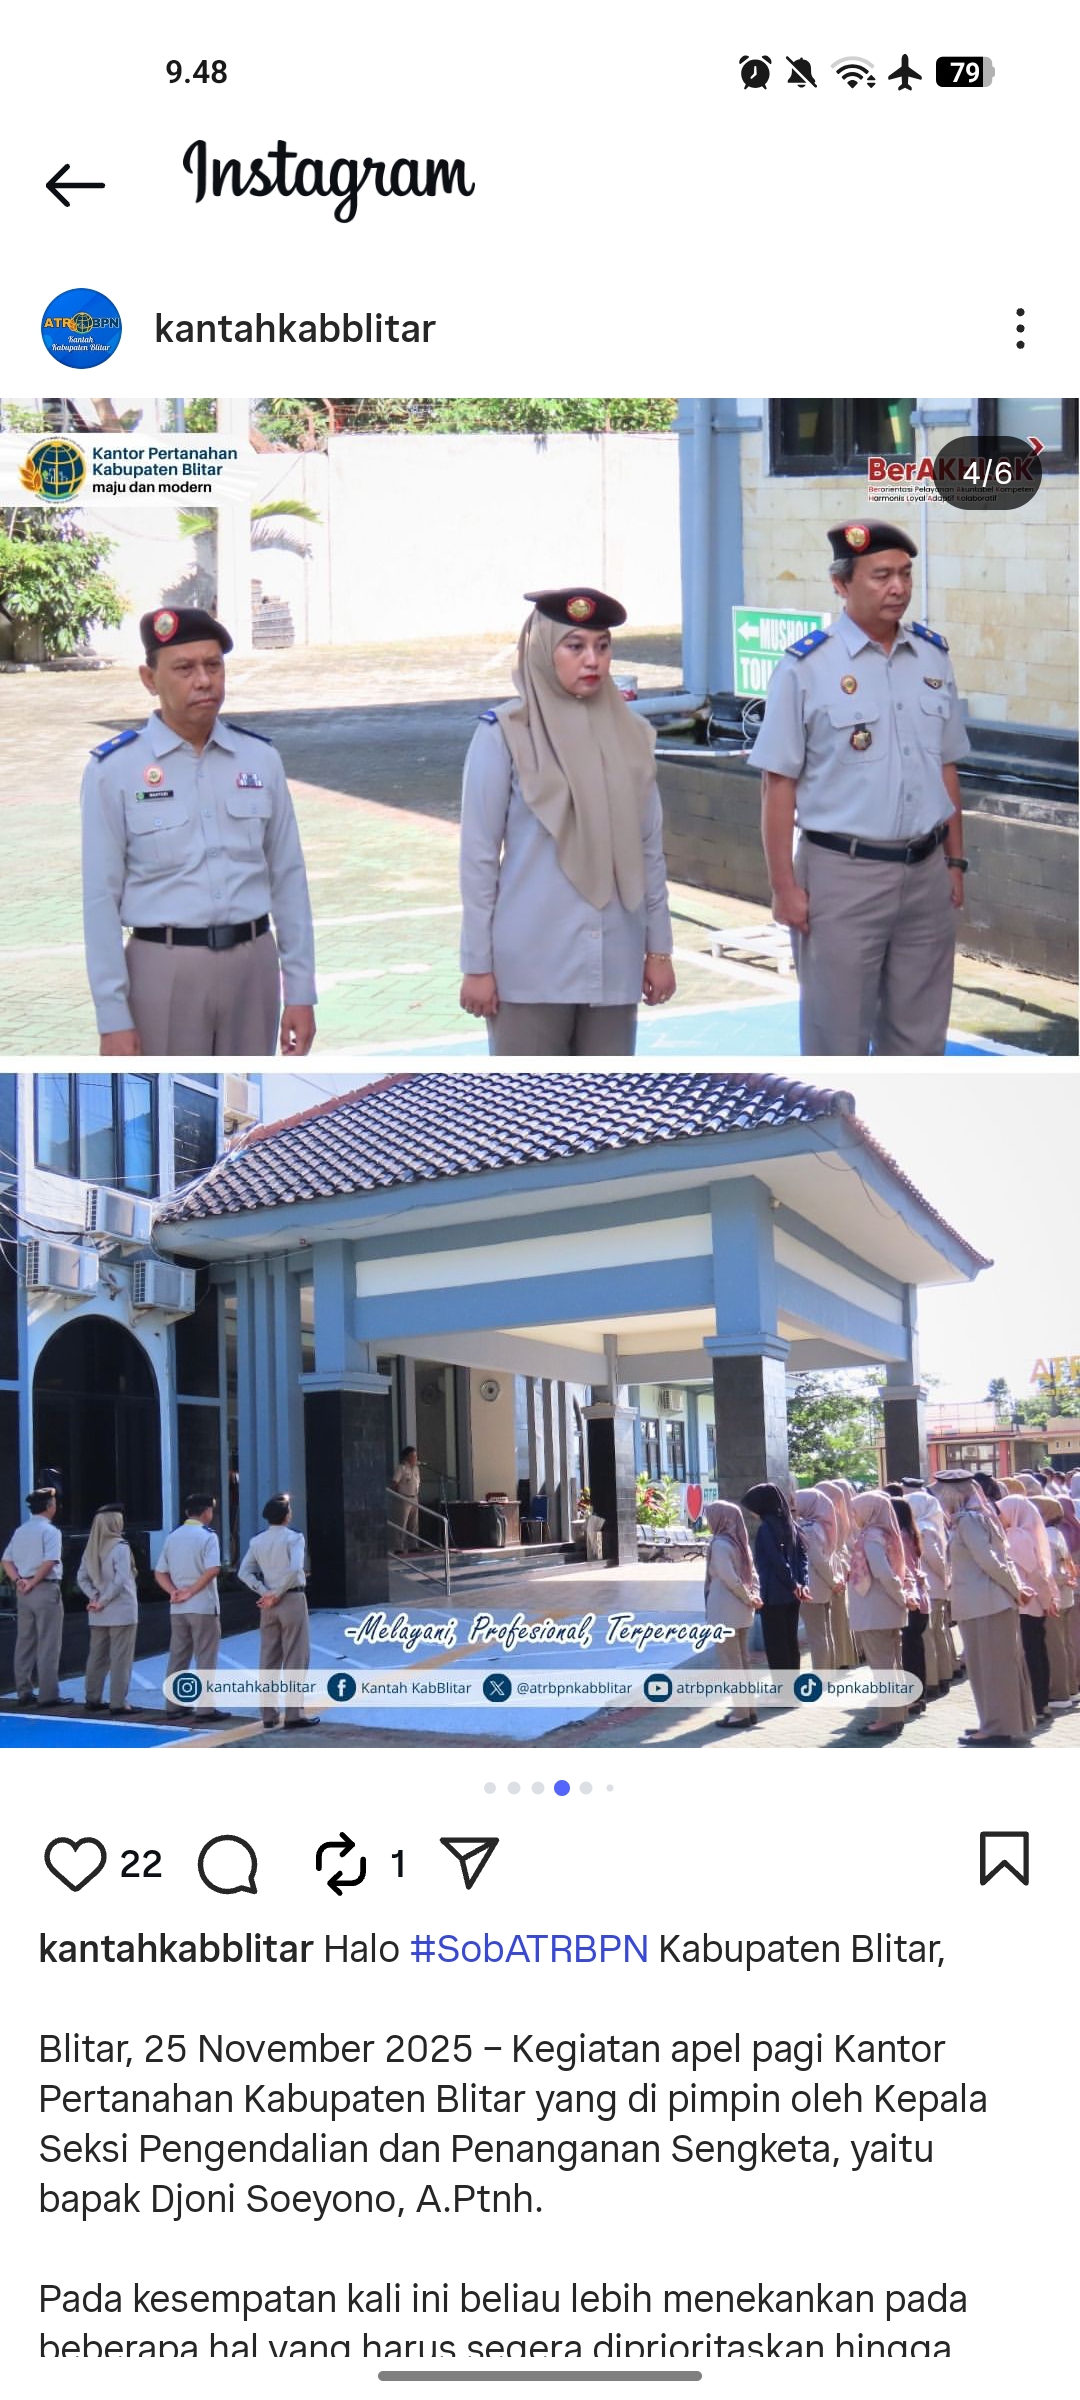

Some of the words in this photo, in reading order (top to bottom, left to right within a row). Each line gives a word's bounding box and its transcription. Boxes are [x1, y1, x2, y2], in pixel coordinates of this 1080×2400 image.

[166, 60, 227, 84] 9.48
[950, 62, 980, 83] 79
[183, 139, 475, 224] Instagram
[92, 317, 120, 329] BPN
[156, 312, 437, 343] kantahkabblitar
[52, 344, 88, 353] Kabupaten
[963, 459, 1012, 488] 4/6
[120, 1849, 162, 1878] 22
[392, 1849, 404, 1878] 1
[41, 1933, 314, 1962] kantahkabblitar
[326, 1933, 399, 1962] Halo
[410, 1933, 647, 1962] #SobATRBPN
[661, 1933, 839, 1971] Kabupaten
[853, 1933, 945, 1968] Blitar,
[41, 2033, 132, 2067] Blitar,
[145, 2035, 185, 2062] 25
[200, 2033, 374, 2062] November
[386, 2035, 471, 2062] 2025
[514, 2033, 659, 2071] Kegiatan
[672, 2033, 739, 2071] apel
[754, 2033, 822, 2071] pagi
[836, 2035, 945, 2062] Kantor
[41, 2083, 232, 2112] Pertanahan
[246, 2083, 424, 2121] Kabupaten
[438, 2083, 525, 2112] Blitar
[536, 2091, 615, 2121] yang
[629, 2083, 656, 2112] di
[670, 2083, 779, 2121] pimpin
[792, 2083, 861, 2112] oleh
[876, 2083, 986, 2121] Kepala
[40, 2133, 127, 2162] Seksi
[141, 2133, 367, 2171] Pengendalian
[380, 2133, 439, 2162] dan
[453, 2134, 659, 2171] Penanganan
[670, 2133, 839, 2171] Sengketa,
[851, 2133, 932, 2171] yaitu
[41, 2183, 140, 2221] bapak
[153, 2183, 234, 2221] Djoni
[247, 2184, 404, 2221] Soeyono,
[416, 2183, 541, 2212] A.Ptnh.
[41, 2283, 121, 2312] Pada
[135, 2283, 335, 2321] kesempatan
[349, 2283, 400, 2312] kali
[413, 2283, 448, 2312] ini
[462, 2283, 559, 2312] beliau
[573, 2283, 650, 2312] lebih
[665, 2283, 873, 2312] menekankan
[887, 2283, 966, 2321] pada
[211, 2333, 256, 2357] hal
[364, 2333, 455, 2357] harus
